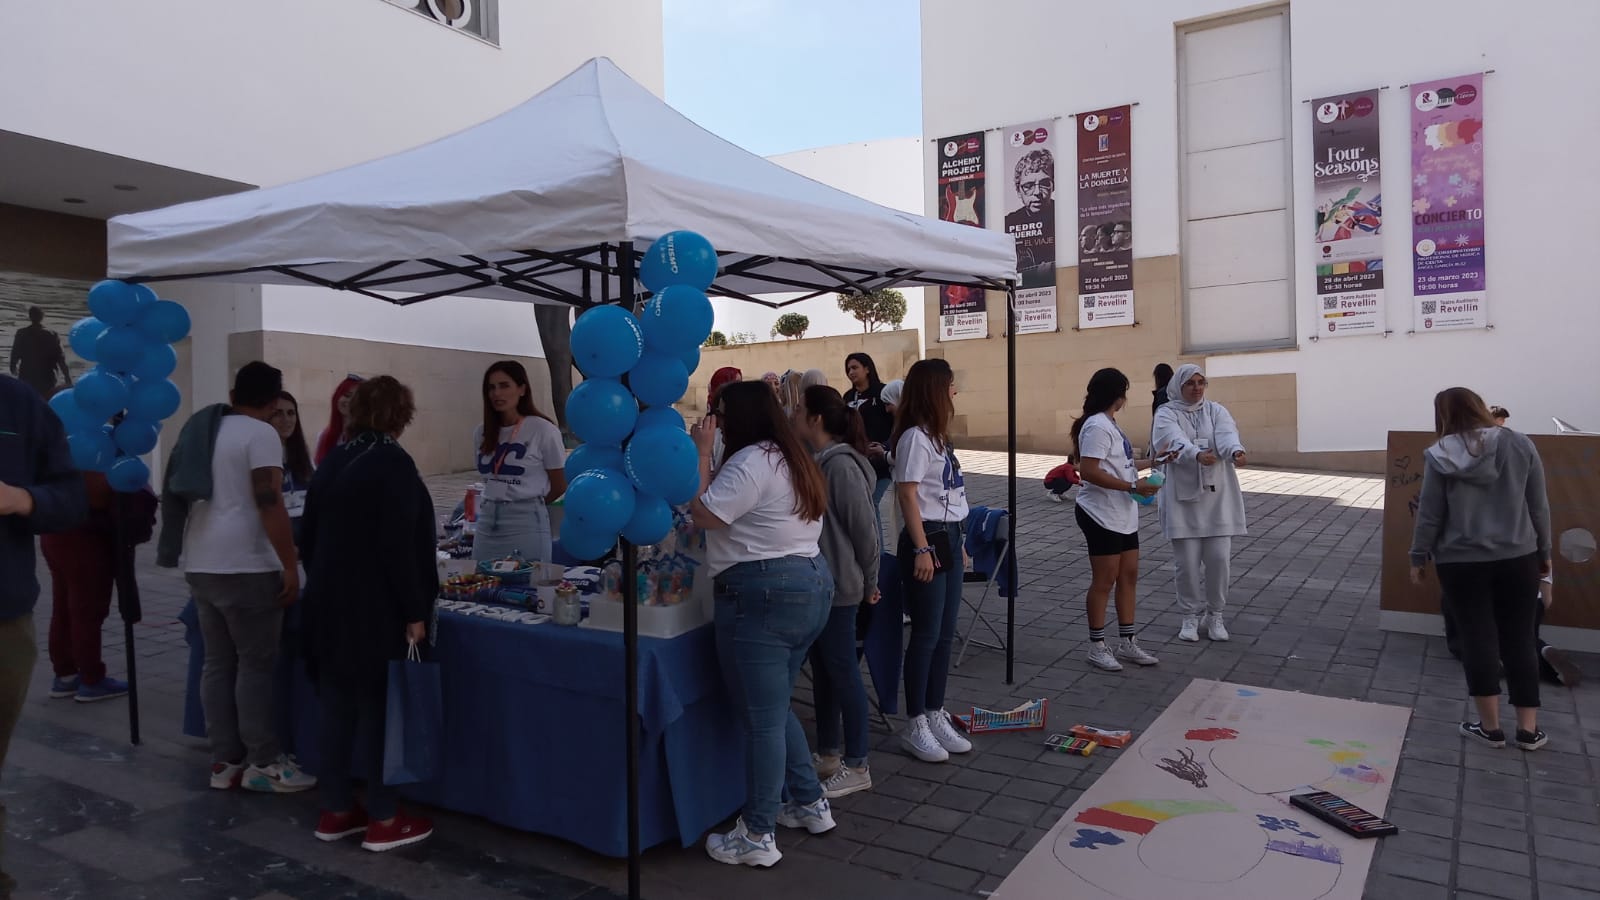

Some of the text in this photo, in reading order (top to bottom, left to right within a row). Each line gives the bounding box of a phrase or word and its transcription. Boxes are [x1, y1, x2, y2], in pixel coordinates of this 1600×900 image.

[1328, 147, 1365, 163] Four
[942, 156, 981, 169] ALCHEMY
[942, 164, 982, 177] PROJECT
[1080, 167, 1128, 182] LA MUERTE Y
[1315, 158, 1379, 182] Seasons
[1080, 177, 1129, 189] LA DONCELLA
[1414, 208, 1483, 226] CONCIERTO
[1009, 222, 1043, 233] PEDRO
[1012, 229, 1043, 239] UERRA
[1024, 236, 1055, 247] EL VIAJE
[1461, 271, 1479, 279] 2023
[1438, 282, 1459, 290] horas
